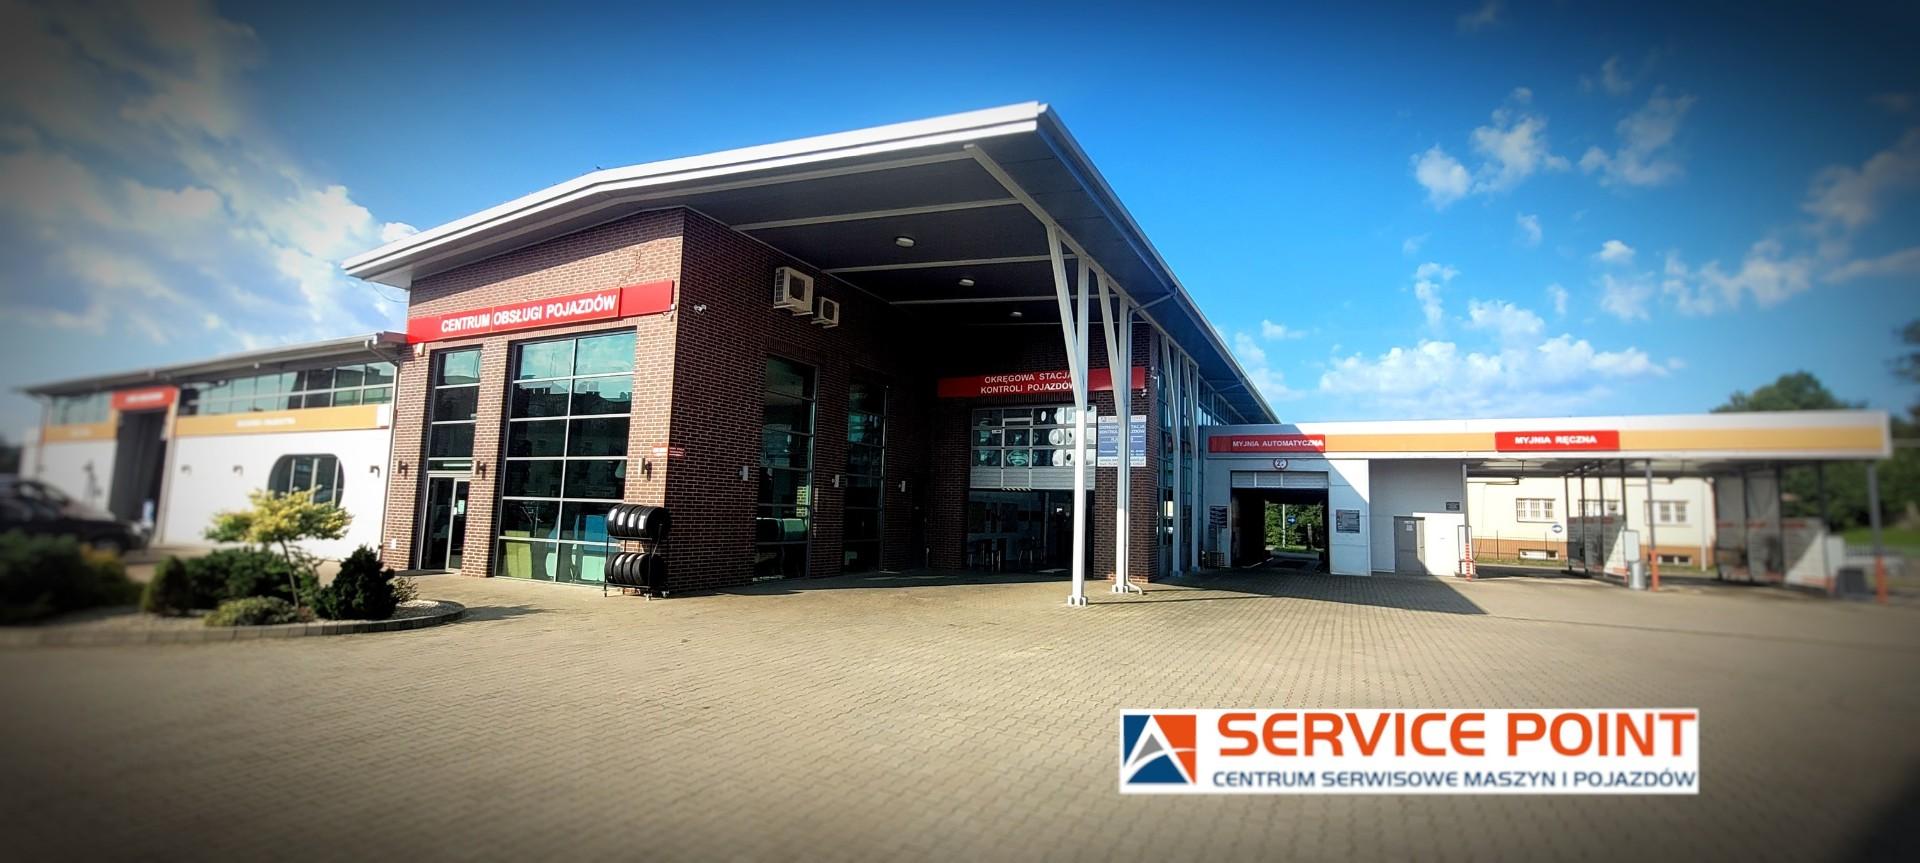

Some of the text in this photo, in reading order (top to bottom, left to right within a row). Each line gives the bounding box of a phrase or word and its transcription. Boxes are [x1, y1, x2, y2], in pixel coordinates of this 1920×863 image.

[441, 294, 617, 333] CENTRUM OBSŁUGI POJAZDÓW
[984, 373, 1035, 384] OKRĘGOWA
[980, 384, 1023, 394] KONTROLI
[1232, 438, 1324, 448] MYJNIA AUTOMATYCZNA
[1514, 435, 1597, 445] MYJNIA RĘCZNA
